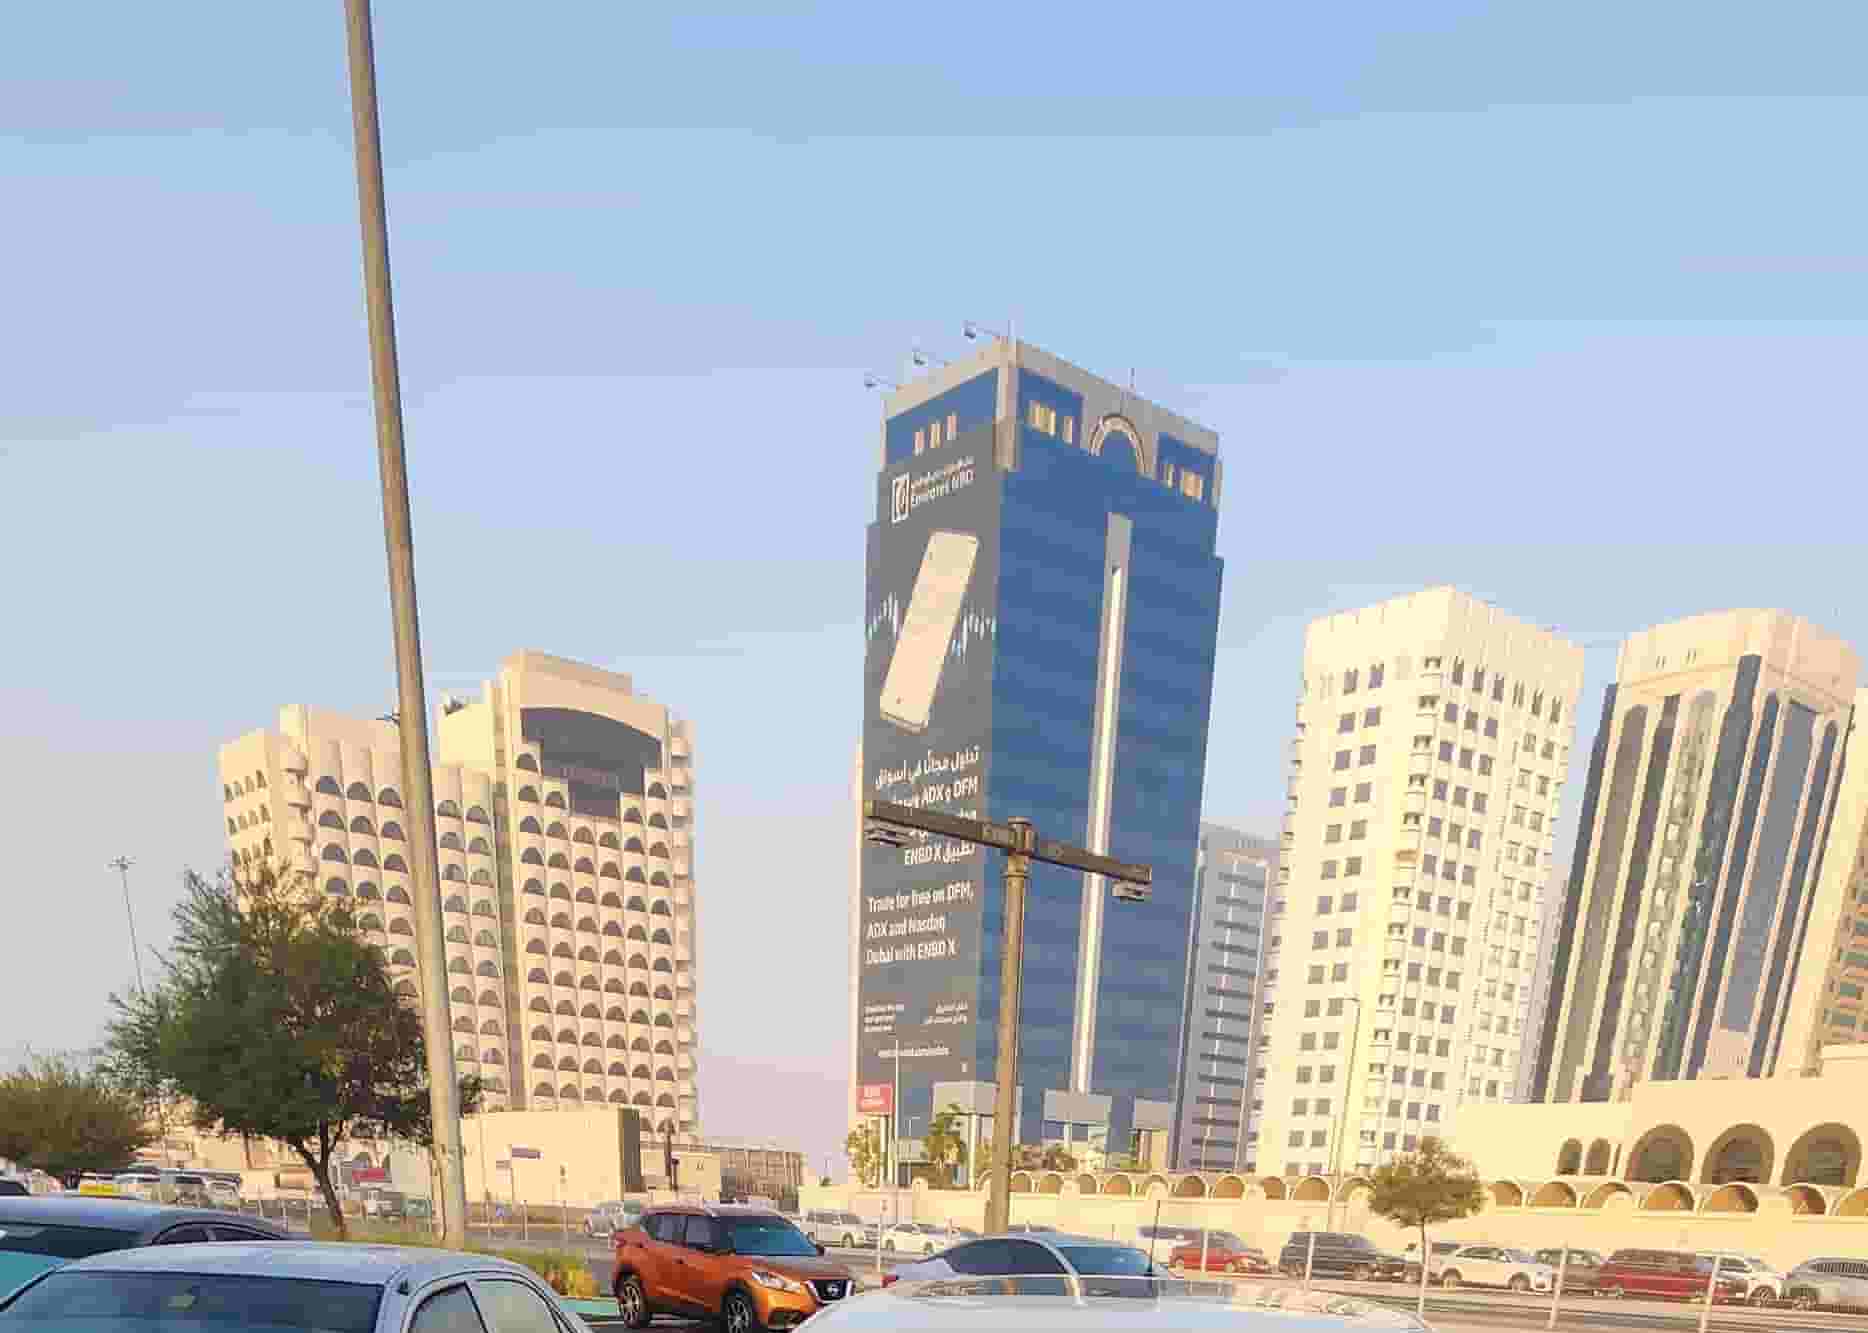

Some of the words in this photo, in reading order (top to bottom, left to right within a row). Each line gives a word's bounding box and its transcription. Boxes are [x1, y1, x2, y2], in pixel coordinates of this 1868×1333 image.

[953, 776, 978, 798] DFM
[896, 889, 910, 910] for
[866, 920, 888, 941] ADX
[889, 918, 907, 937] and
[865, 946, 895, 965] Dubai
[895, 943, 917, 961] with
